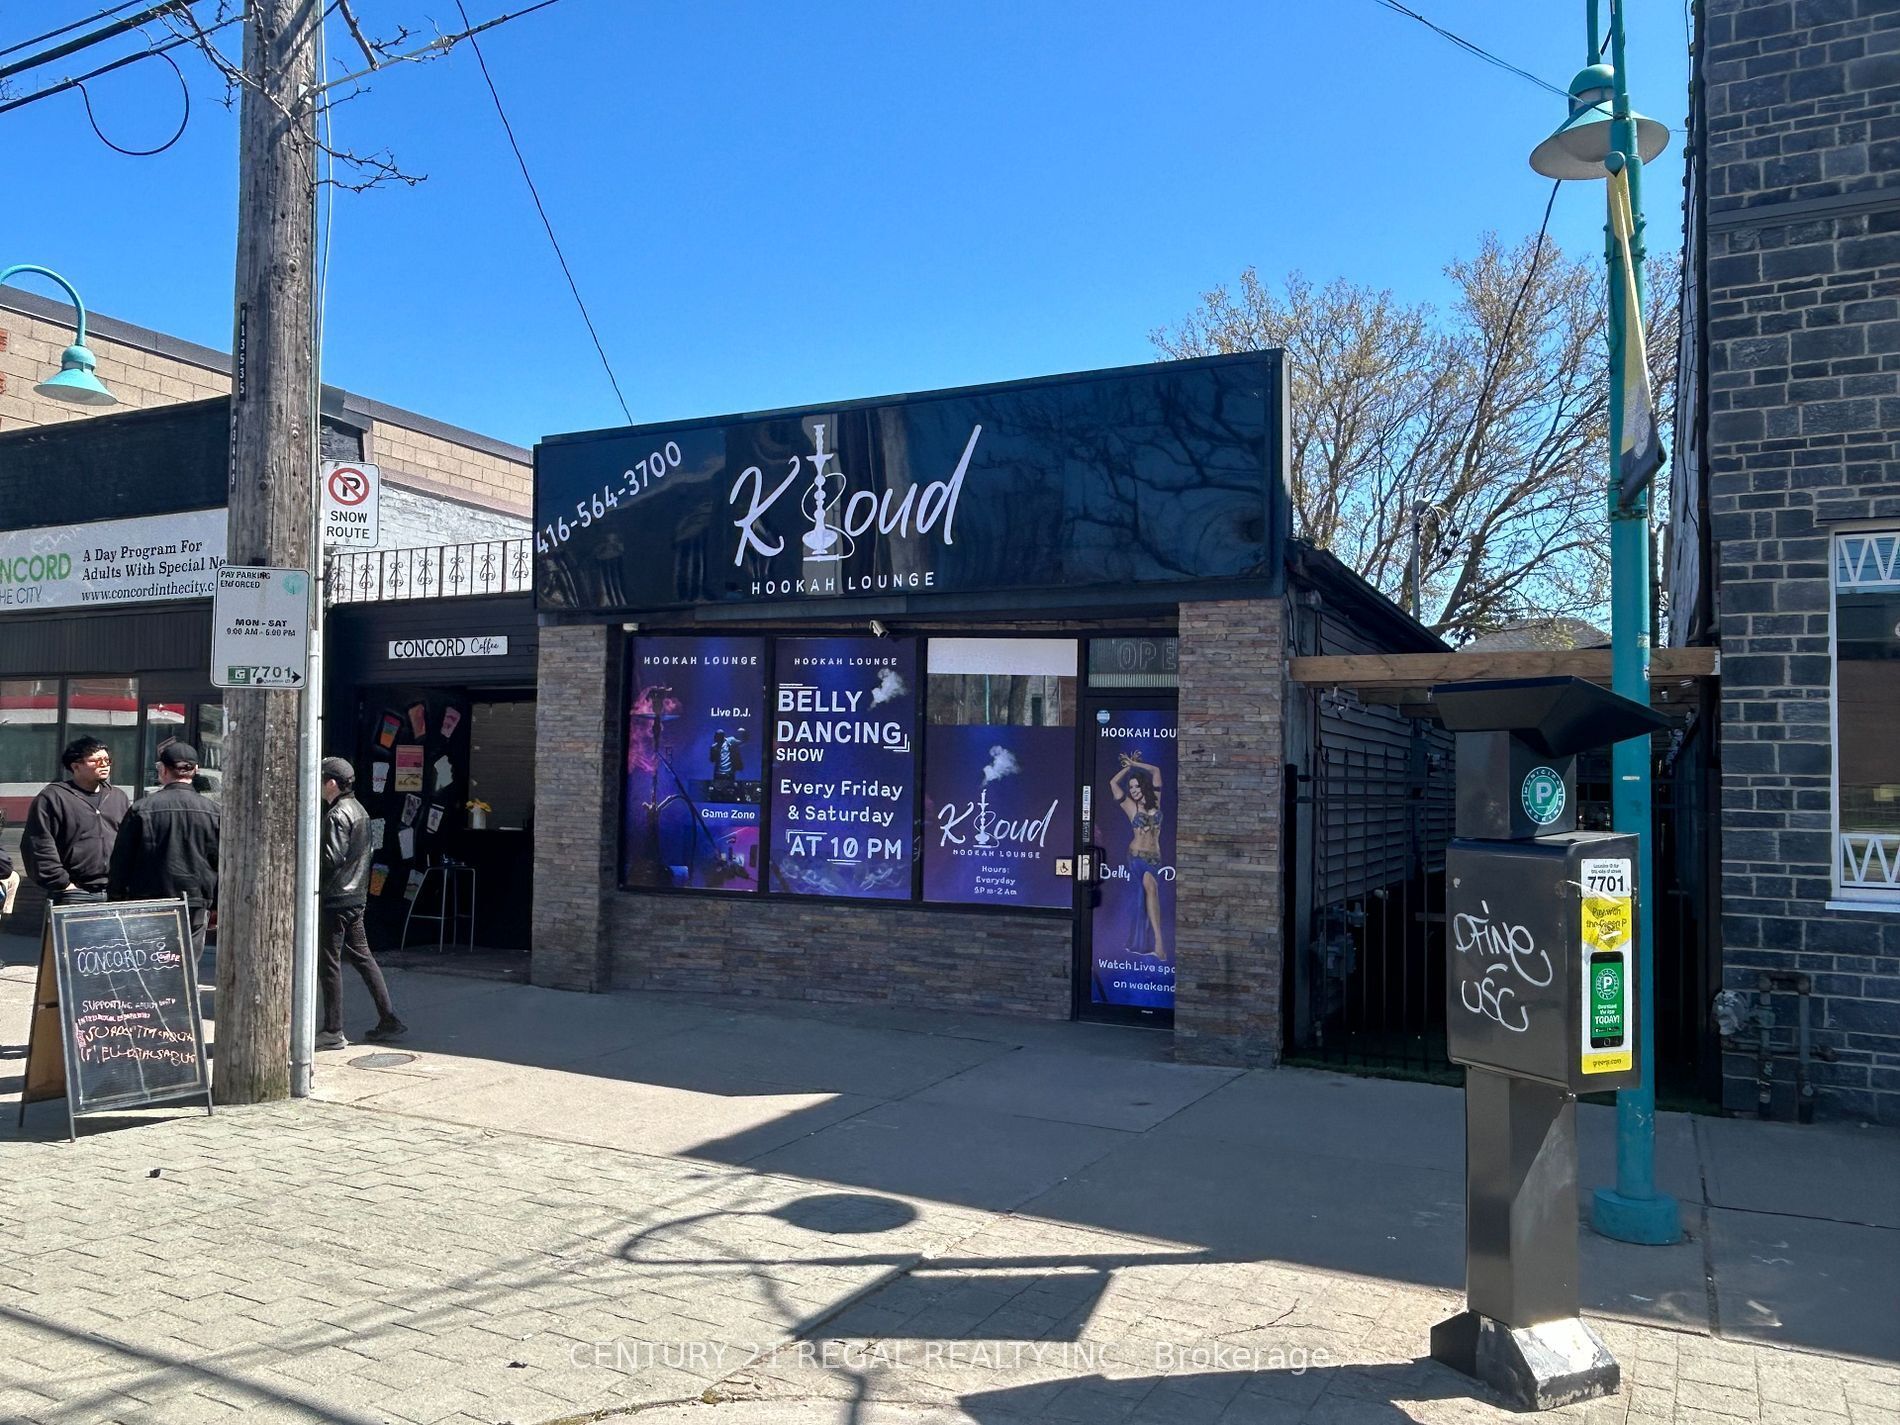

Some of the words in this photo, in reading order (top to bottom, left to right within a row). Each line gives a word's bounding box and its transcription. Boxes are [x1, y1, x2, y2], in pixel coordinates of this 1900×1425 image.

[536, 440, 682, 554] 416-564-3700
[330, 510, 367, 524] SNOW
[326, 525, 370, 540] ROUTE
[83, 549, 91, 562] A
[95, 548, 117, 563] Day
[120, 546, 176, 560] Program
[180, 540, 203, 553] For
[82, 566, 121, 581] Adults
[125, 562, 155, 577] With
[158, 557, 205, 577] Special
[751, 577, 835, 595] HOOKAH
[848, 571, 934, 590] LOUNGE
[16, 586, 42, 604] CITY
[235, 618, 260, 627] MON
[267, 619, 288, 628] SAT
[394, 639, 466, 658] CONCORD
[470, 637, 500, 655] Coffee
[643, 656, 698, 666] HOOKAH
[704, 656, 757, 666] LOUNGE
[794, 657, 843, 666] HOOKAH
[849, 657, 897, 666] LOUNGE
[251, 666, 292, 679] 7701
[778, 690, 863, 713] BELLY
[711, 707, 730, 717] Live
[732, 707, 751, 717] D.J.
[776, 720, 902, 744] DANCING
[1101, 727, 1150, 738] HOOKAH
[1153, 728, 1177, 738] LOU
[776, 748, 824, 762] SHOW
[780, 779, 835, 799] Every
[841, 780, 903, 801] Friday
[1536, 782, 1553, 804] P
[701, 808, 729, 820] Game
[731, 809, 756, 820] Zone
[788, 805, 800, 821] &
[804, 805, 894, 827] Saturday
[790, 836, 822, 857] AT
[830, 836, 859, 858] 10
[867, 838, 902, 860] PM
[952, 849, 995, 857] HOOKAH
[1000, 850, 1041, 859] LOUNGE
[981, 865, 1010, 873] Hours:
[1100, 863, 1130, 881] Belly
[975, 876, 1016, 885] Everyday
[1588, 876, 1624, 892] 7701
[77, 949, 146, 974] CONCORD
[1098, 958, 1131, 970] Watch
[1133, 961, 1156, 972] Live
[1113, 980, 1127, 988] on
